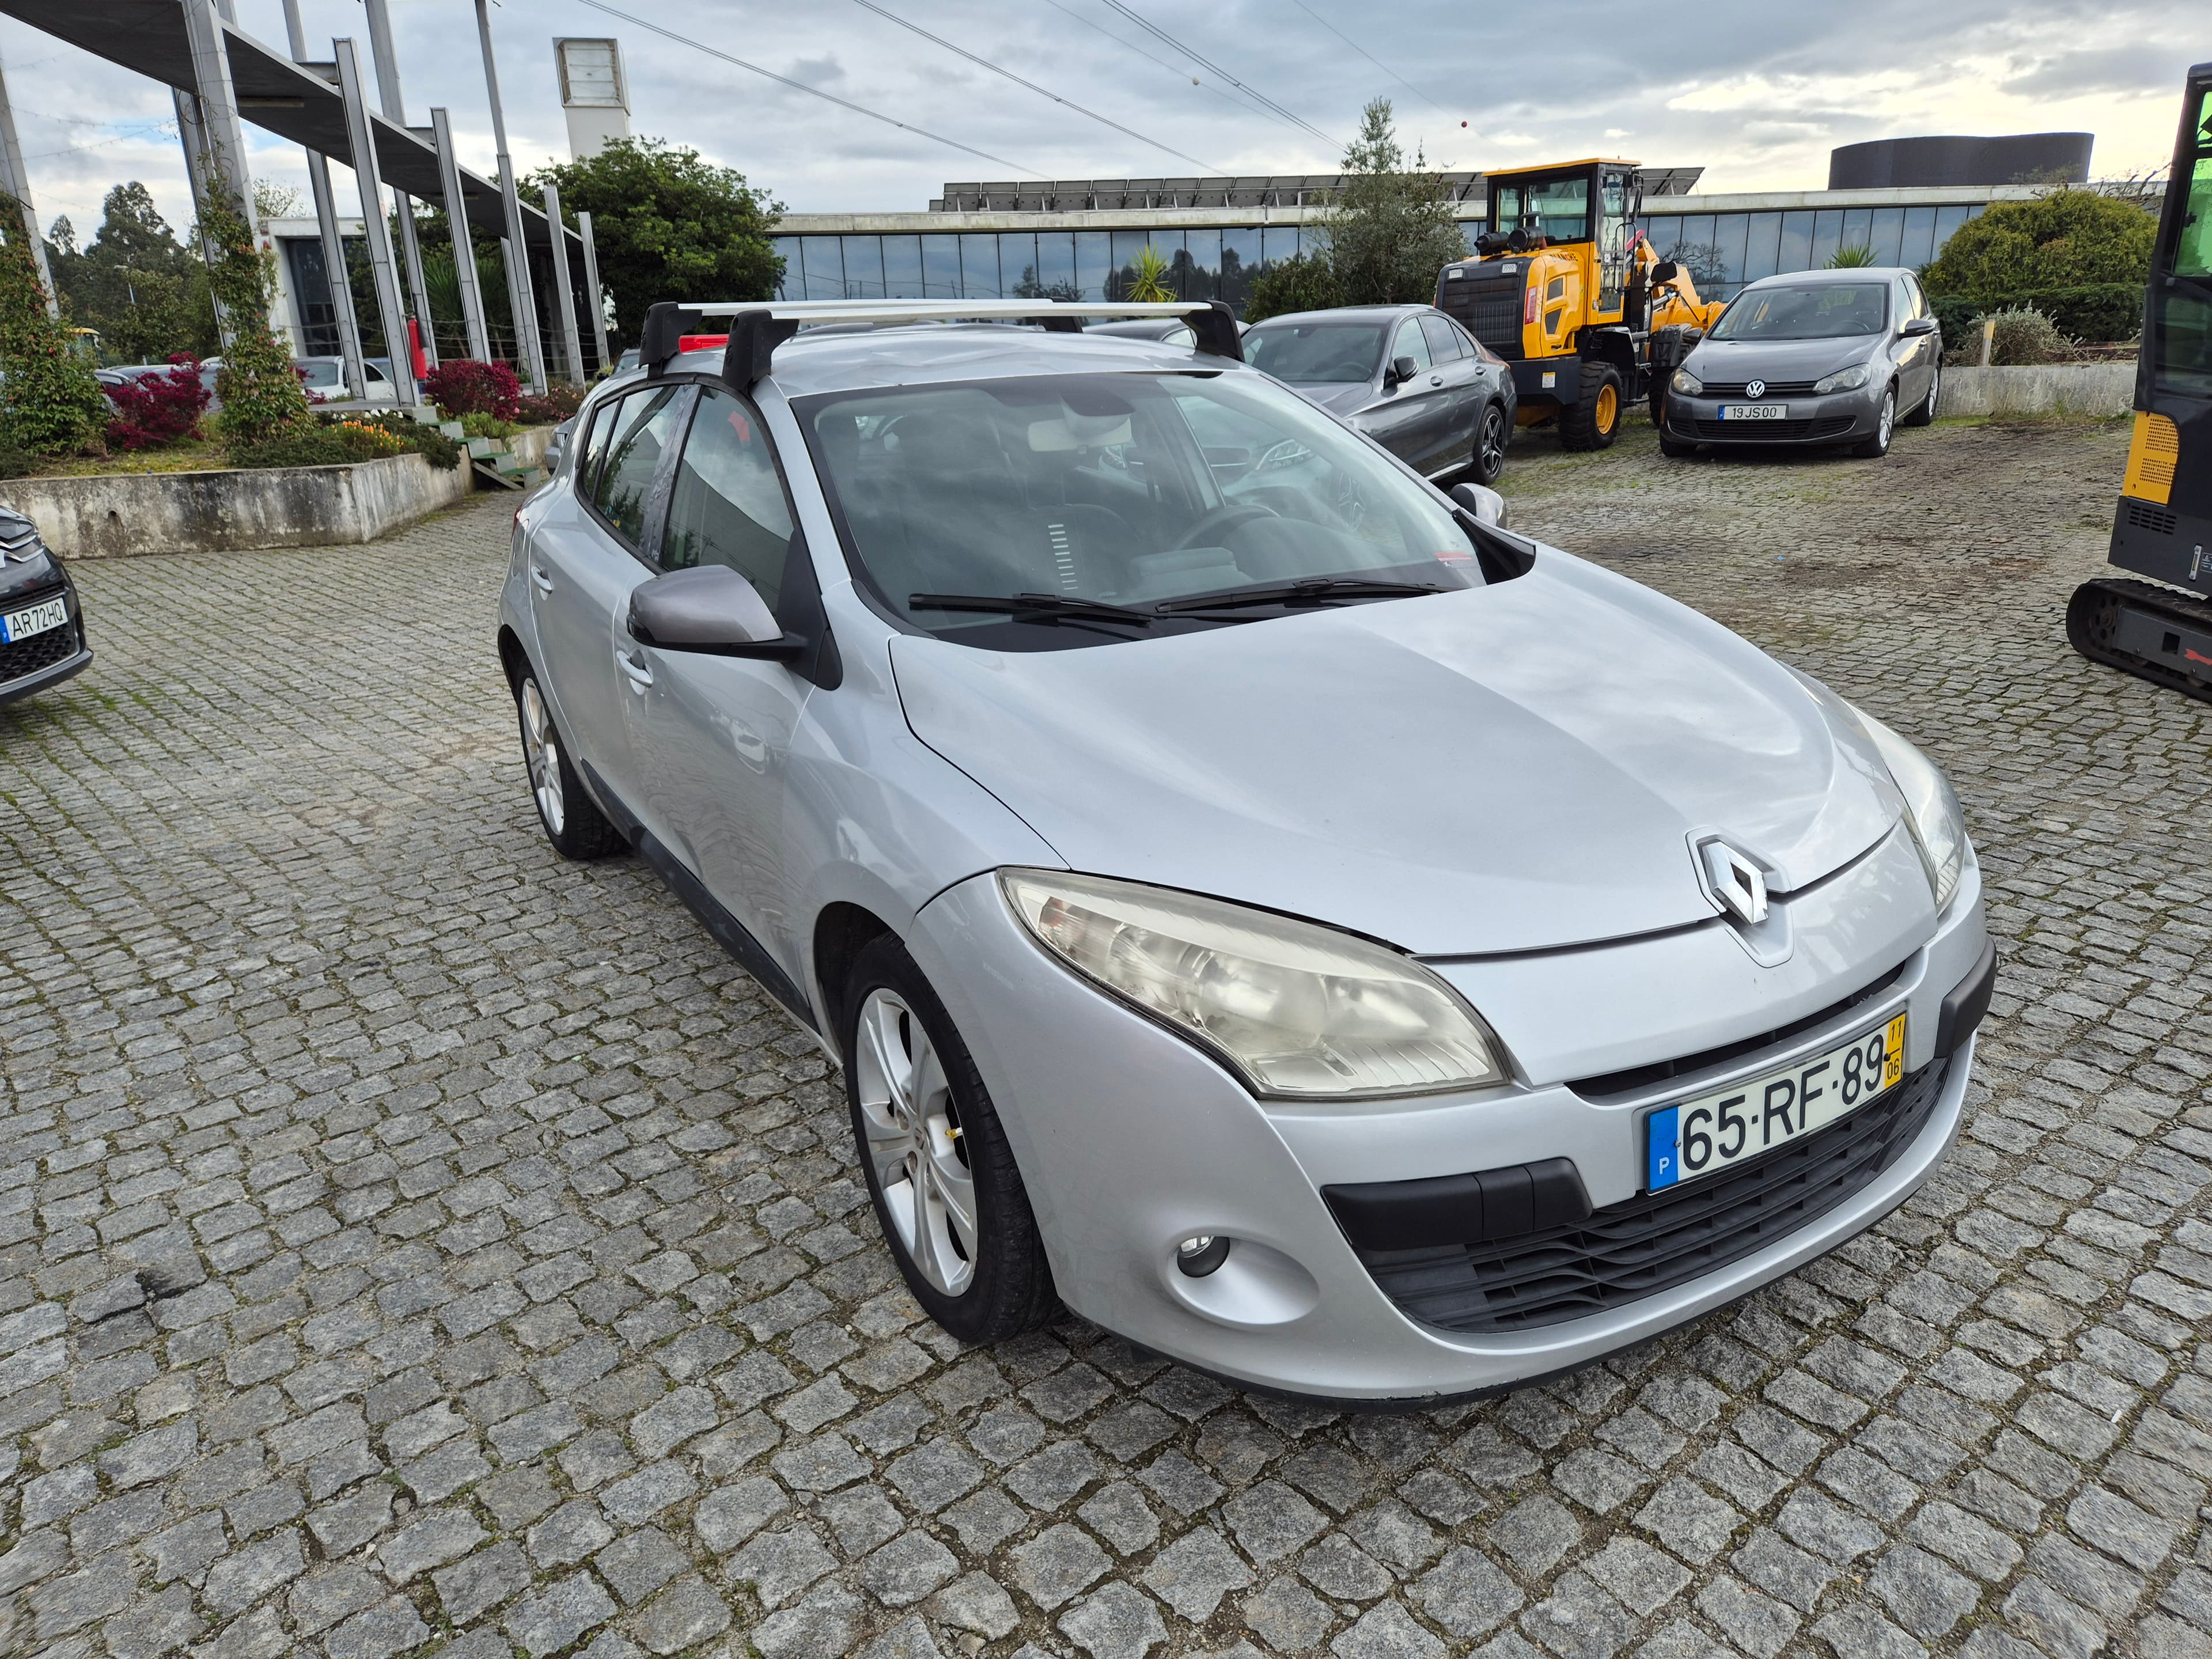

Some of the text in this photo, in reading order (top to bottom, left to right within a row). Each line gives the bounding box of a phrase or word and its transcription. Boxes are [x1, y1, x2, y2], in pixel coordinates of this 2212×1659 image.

[1892, 1019, 1902, 1042] 11
[1887, 1058, 1900, 1080] 06
[1659, 1157, 1670, 1175] P
